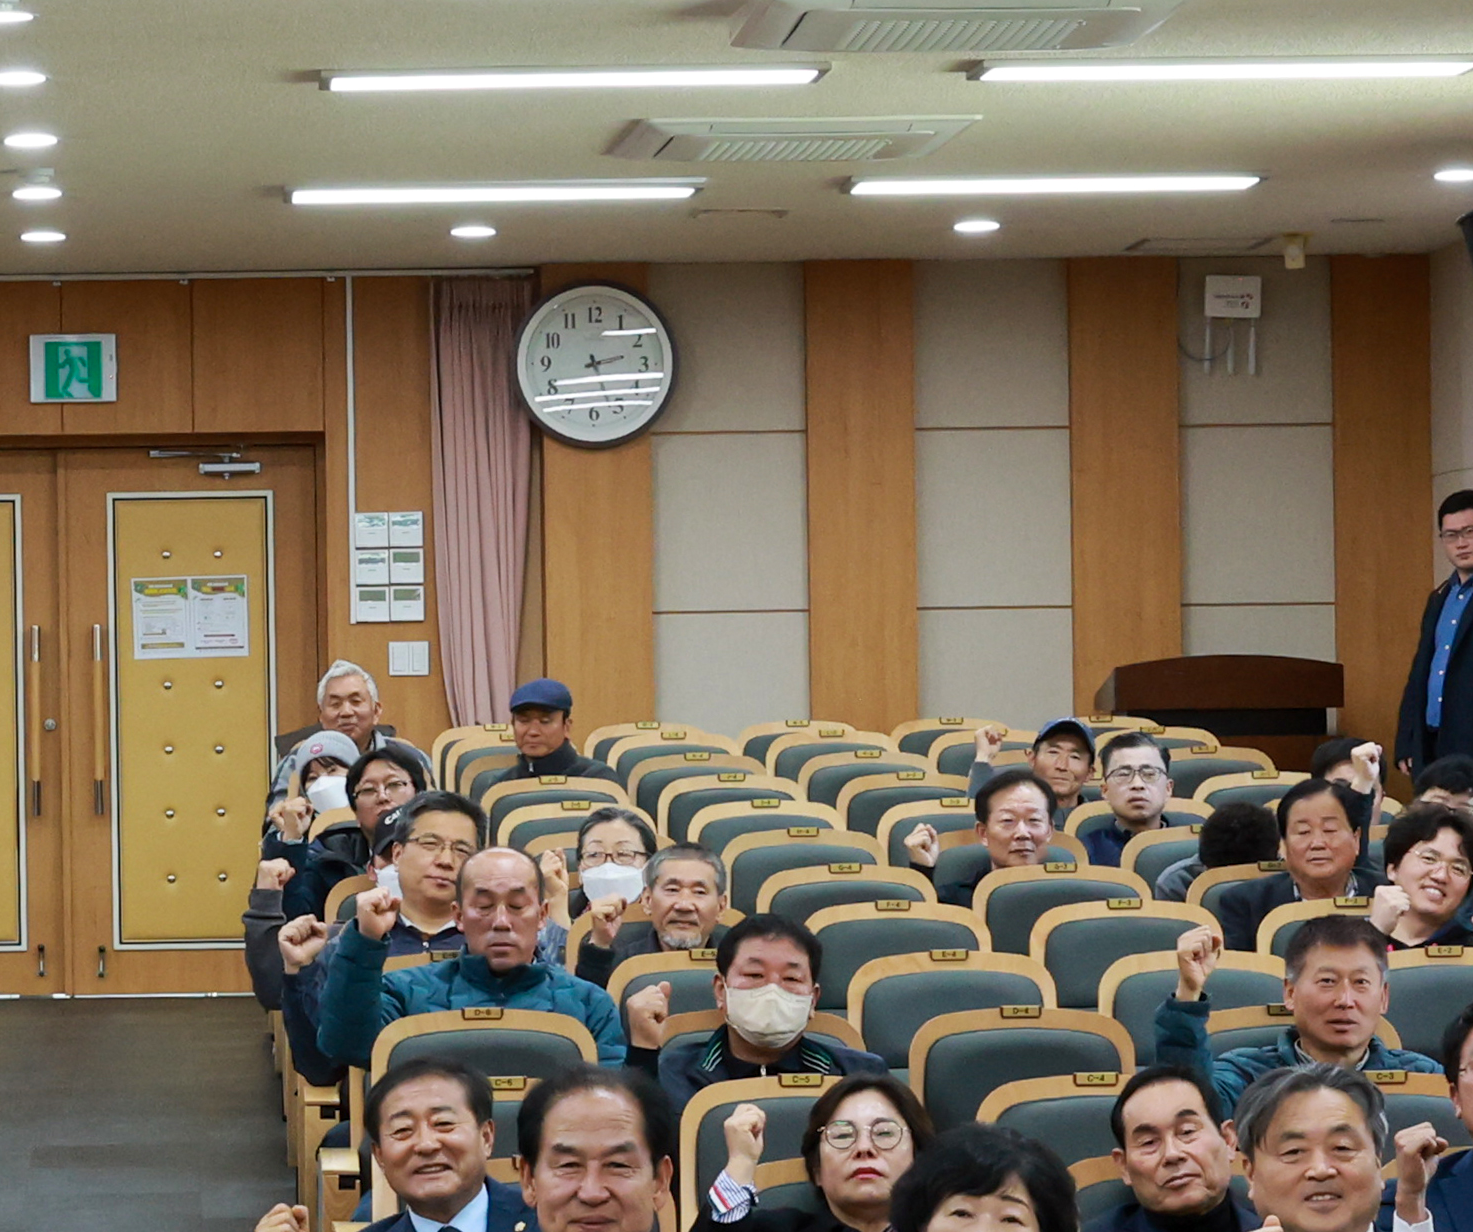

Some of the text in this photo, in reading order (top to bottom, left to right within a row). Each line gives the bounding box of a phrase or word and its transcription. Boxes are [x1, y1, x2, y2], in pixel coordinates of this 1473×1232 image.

[564, 313, 576, 329] 11
[588, 307, 602, 323] 12
[617, 315, 624, 330] 1
[546, 333, 560, 349] 10
[632, 334, 643, 348] 2
[540, 356, 551, 372] 9
[638, 356, 649, 373] 3
[548, 379, 558, 395] 8
[589, 406, 600, 421] 6
[941, 950, 957, 959] E-4
[1437, 946, 1453, 955] E-2
[1012, 1006, 1030, 1016] D-4
[494, 1078, 514, 1087] C-6
[792, 1075, 811, 1084] C-5
[1086, 1074, 1106, 1083] C-4
[1375, 1071, 1395, 1081] C-3
